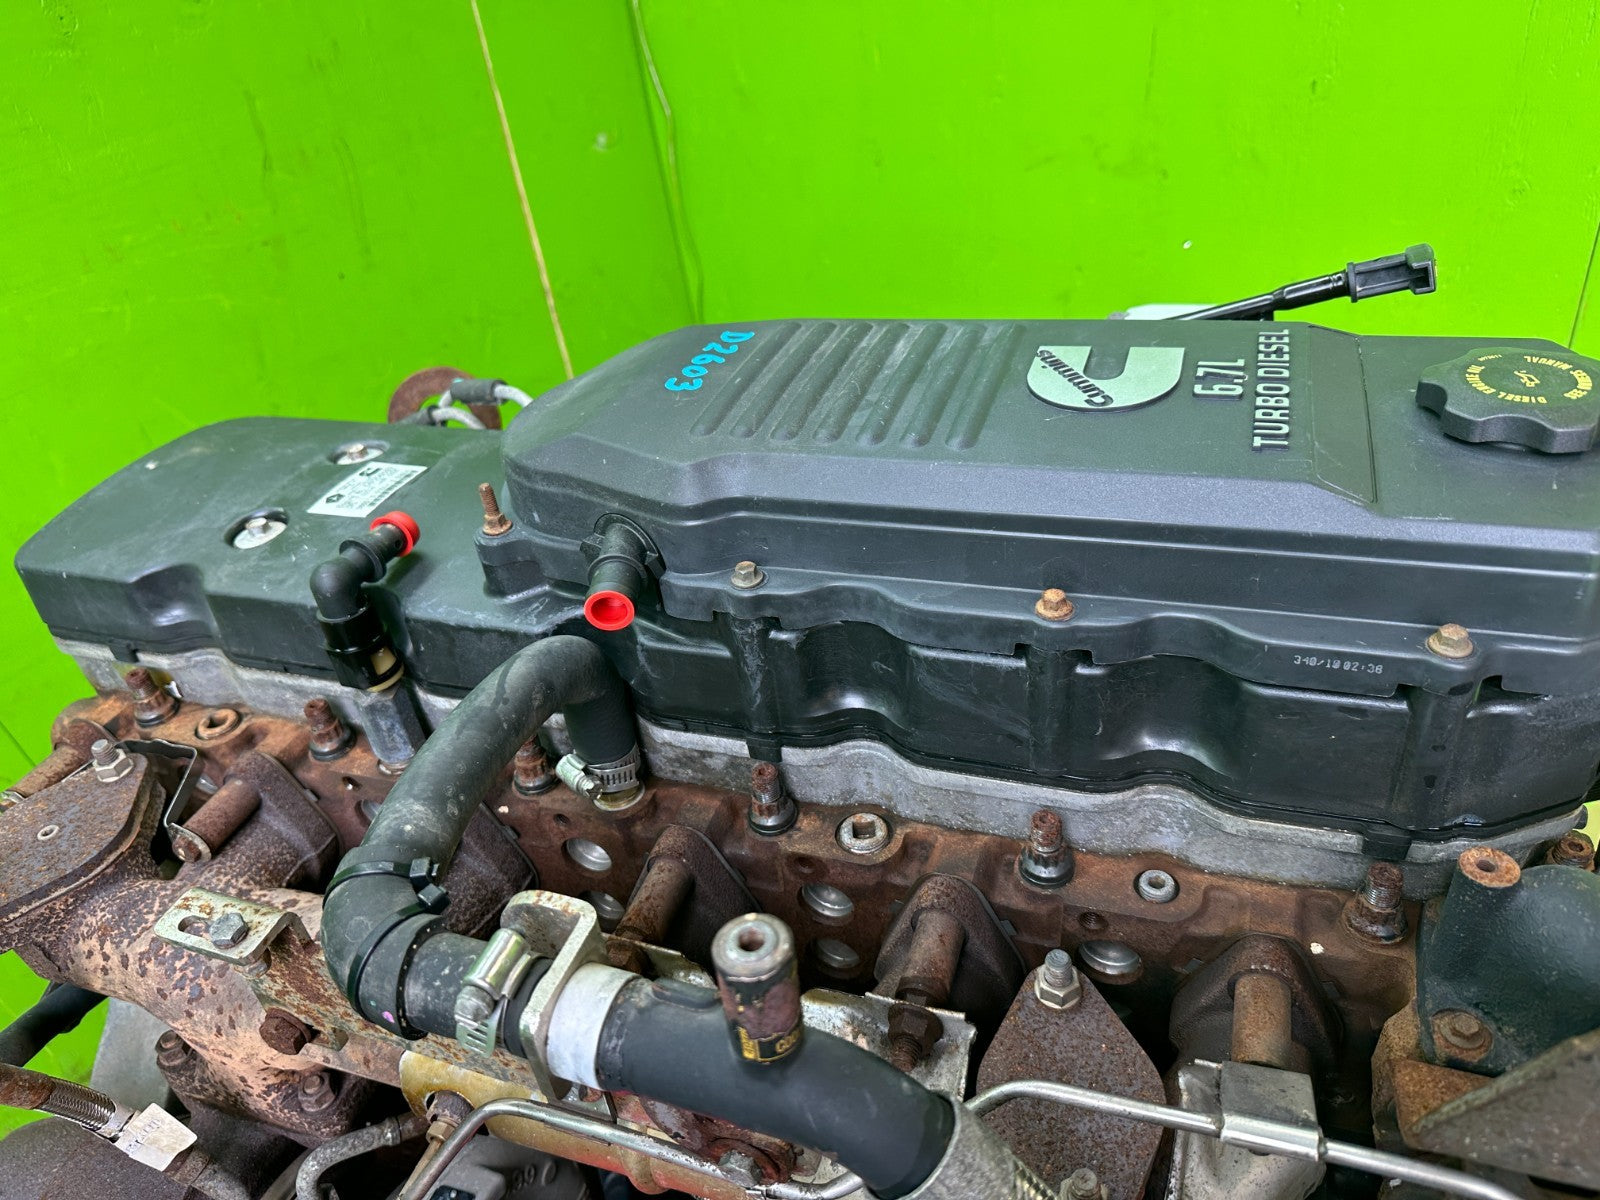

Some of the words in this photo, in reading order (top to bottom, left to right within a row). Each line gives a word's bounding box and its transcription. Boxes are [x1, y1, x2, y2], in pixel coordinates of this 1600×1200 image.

[665, 331, 755, 391] D2603
[1256, 329, 1290, 381] DIESEL
[1523, 355, 1573, 370] MANUAL
[1252, 382, 1291, 450] TURBO
[1498, 391, 1547, 403] DIESEL
